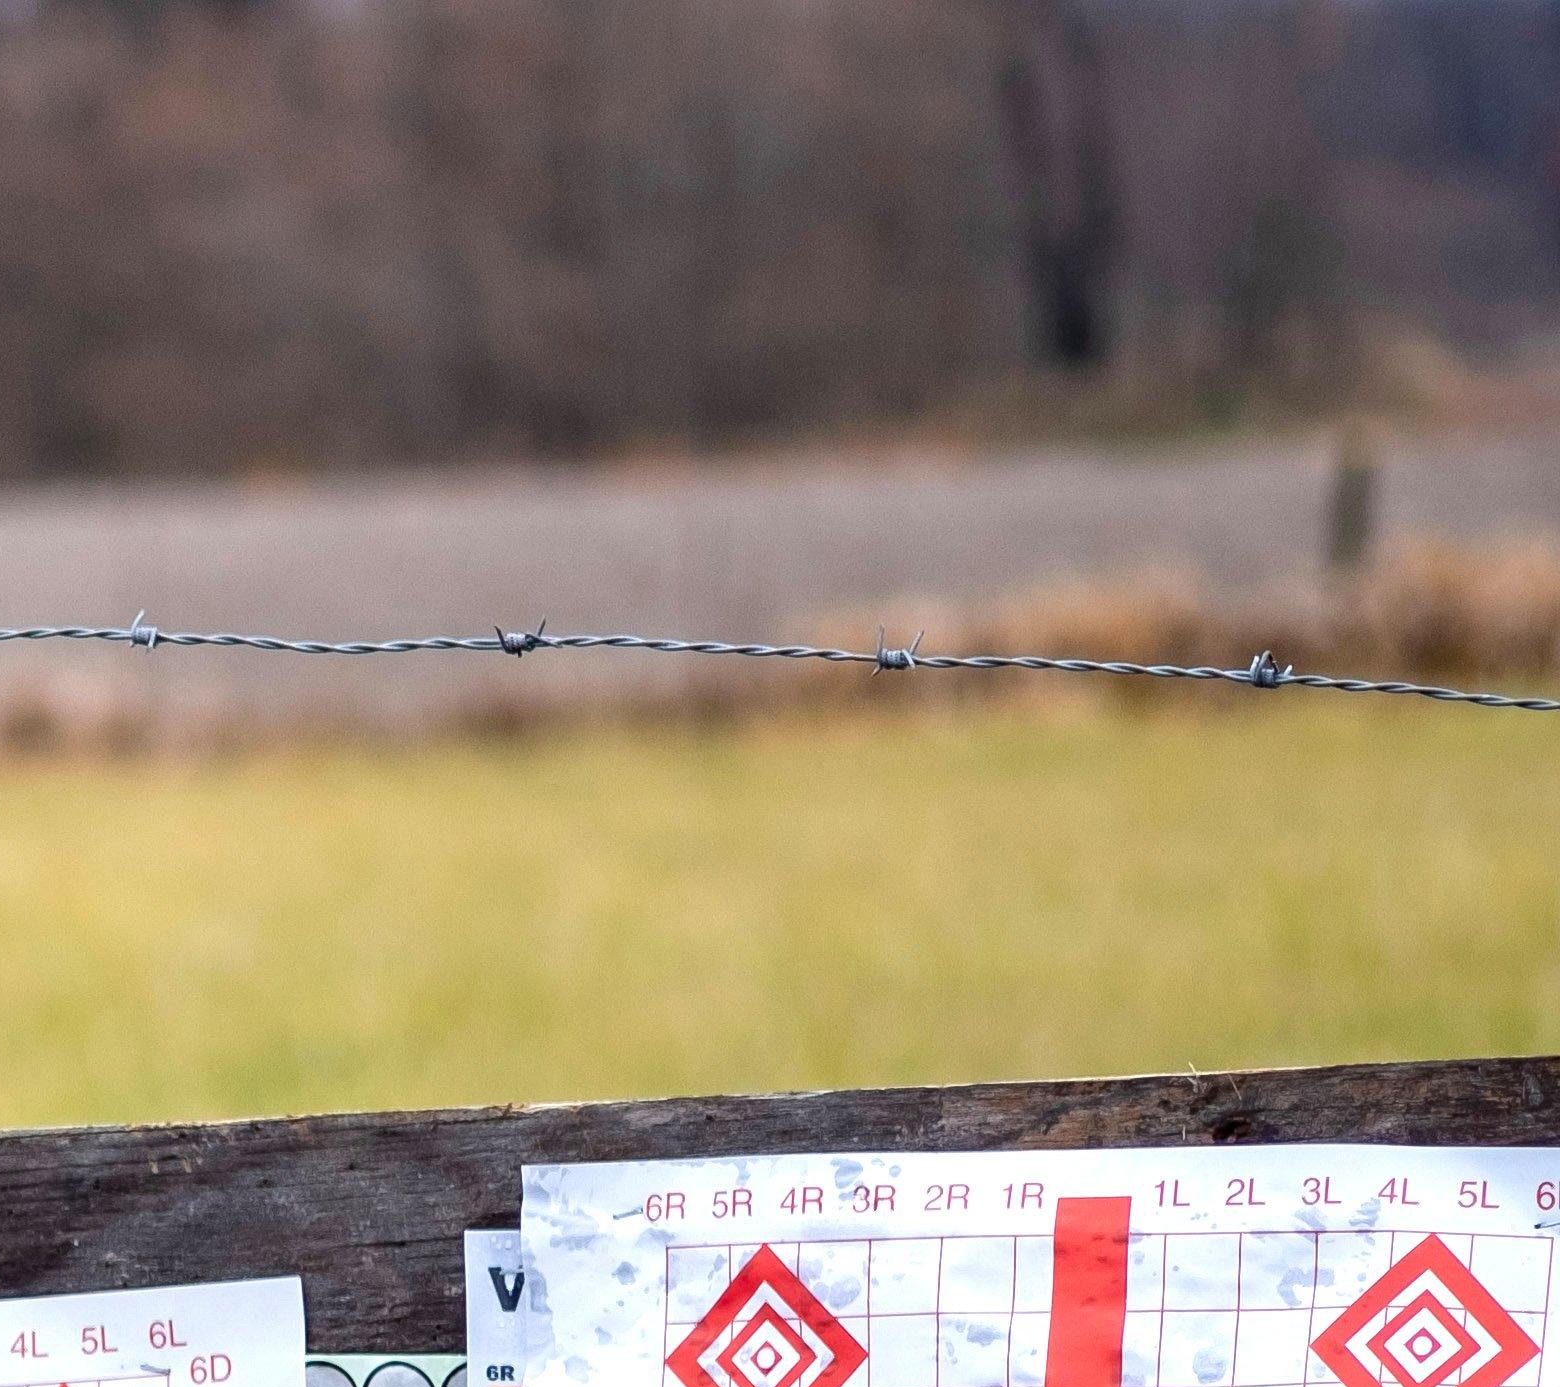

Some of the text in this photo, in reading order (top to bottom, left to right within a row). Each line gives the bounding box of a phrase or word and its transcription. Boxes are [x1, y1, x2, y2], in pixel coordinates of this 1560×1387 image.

[647, 1177, 1560, 1222] 6R 5R 4R 3R 2R 1R 1L 2L 3L 4L 5L 6
[11, 1331, 48, 1358] 4L
[82, 1326, 117, 1354] 5L
[150, 1320, 186, 1349] 6L
[191, 1355, 231, 1384] 6D
[487, 1365, 515, 1382] 6R
